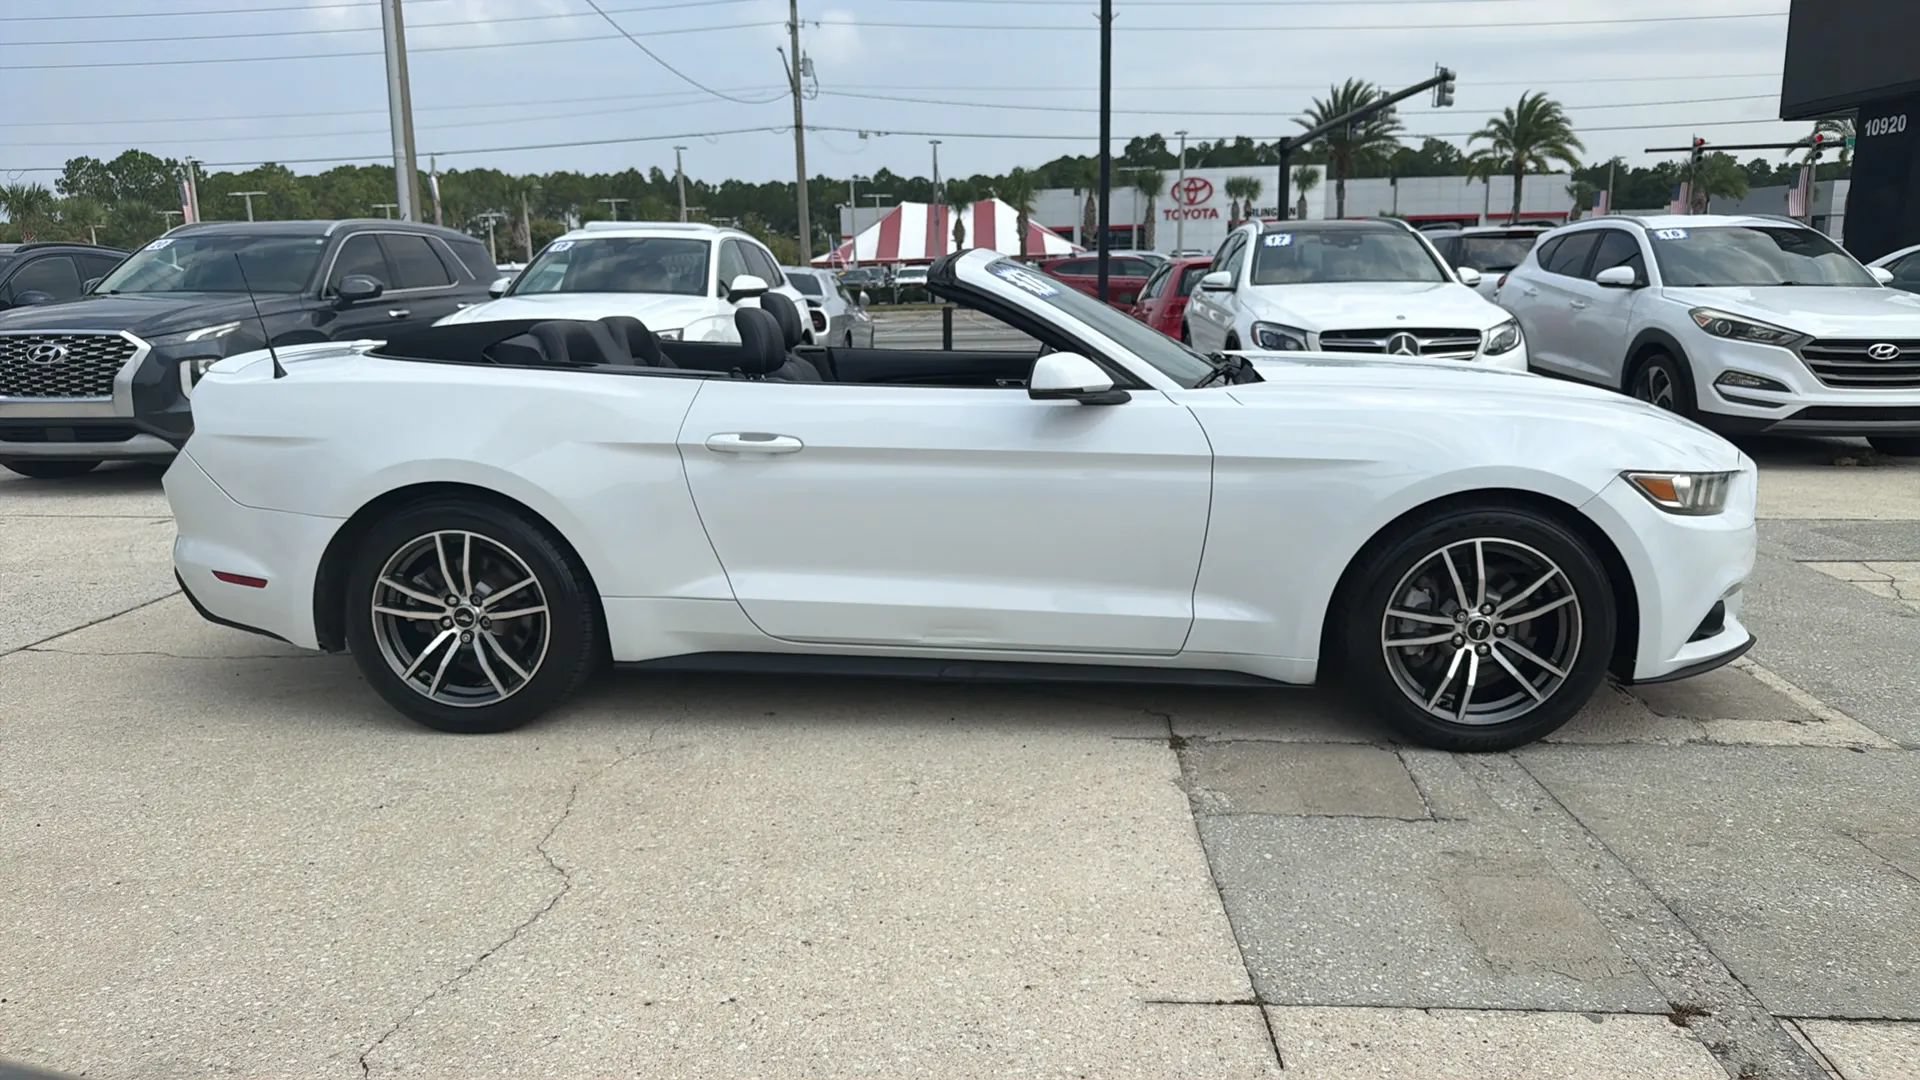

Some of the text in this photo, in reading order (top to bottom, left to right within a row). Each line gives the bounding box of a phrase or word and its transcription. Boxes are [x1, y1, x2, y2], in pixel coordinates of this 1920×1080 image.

[1865, 114, 1907, 136] 10920
[1163, 208, 1219, 220] TOYOTA
[1246, 207, 1296, 217] RLINGN
